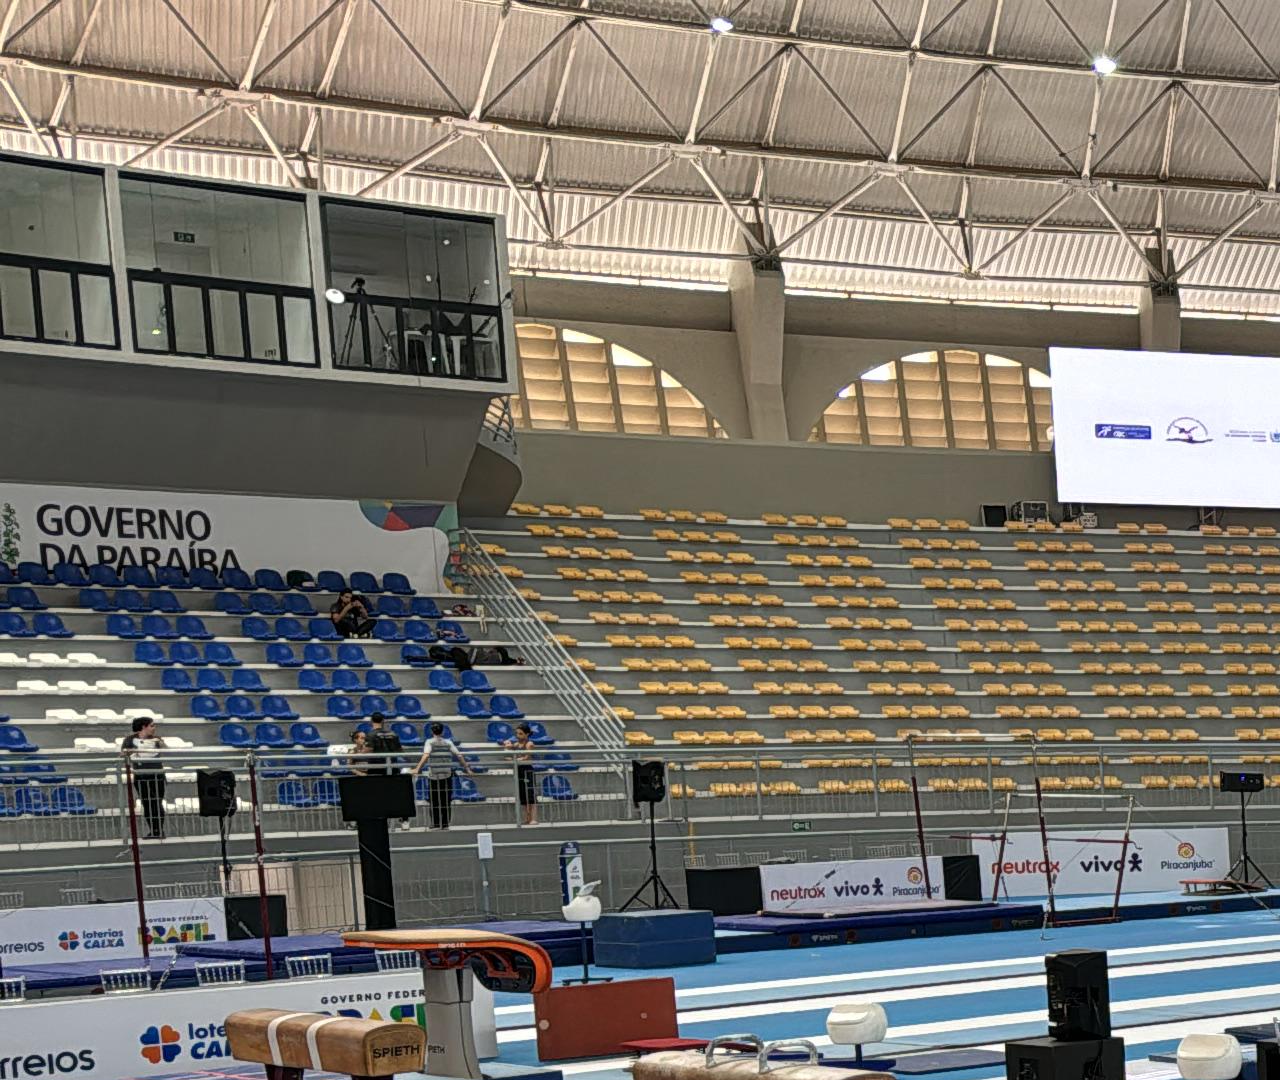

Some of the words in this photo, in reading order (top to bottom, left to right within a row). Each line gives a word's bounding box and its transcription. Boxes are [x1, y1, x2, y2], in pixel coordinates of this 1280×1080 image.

[36, 503, 211, 541] GOVERNO
[991, 859, 1060, 875] neutrox
[1080, 855, 1123, 873] vivo
[1161, 859, 1213, 871] Piracanjuba
[770, 886, 826, 901] neutrox
[833, 880, 870, 898] vivo
[82, 928, 124, 939] loterias
[0, 941, 45, 955] rreios
[83, 938, 125, 950] CAIXA
[320, 992, 382, 1005] GOVERNO
[387, 988, 426, 1001] FEDER
[188, 1023, 227, 1041] lote
[190, 1041, 232, 1060] CAI
[373, 1044, 420, 1060] SPIETH
[427, 1045, 445, 1056] PIETH
[0, 1050, 95, 1079] rreios
